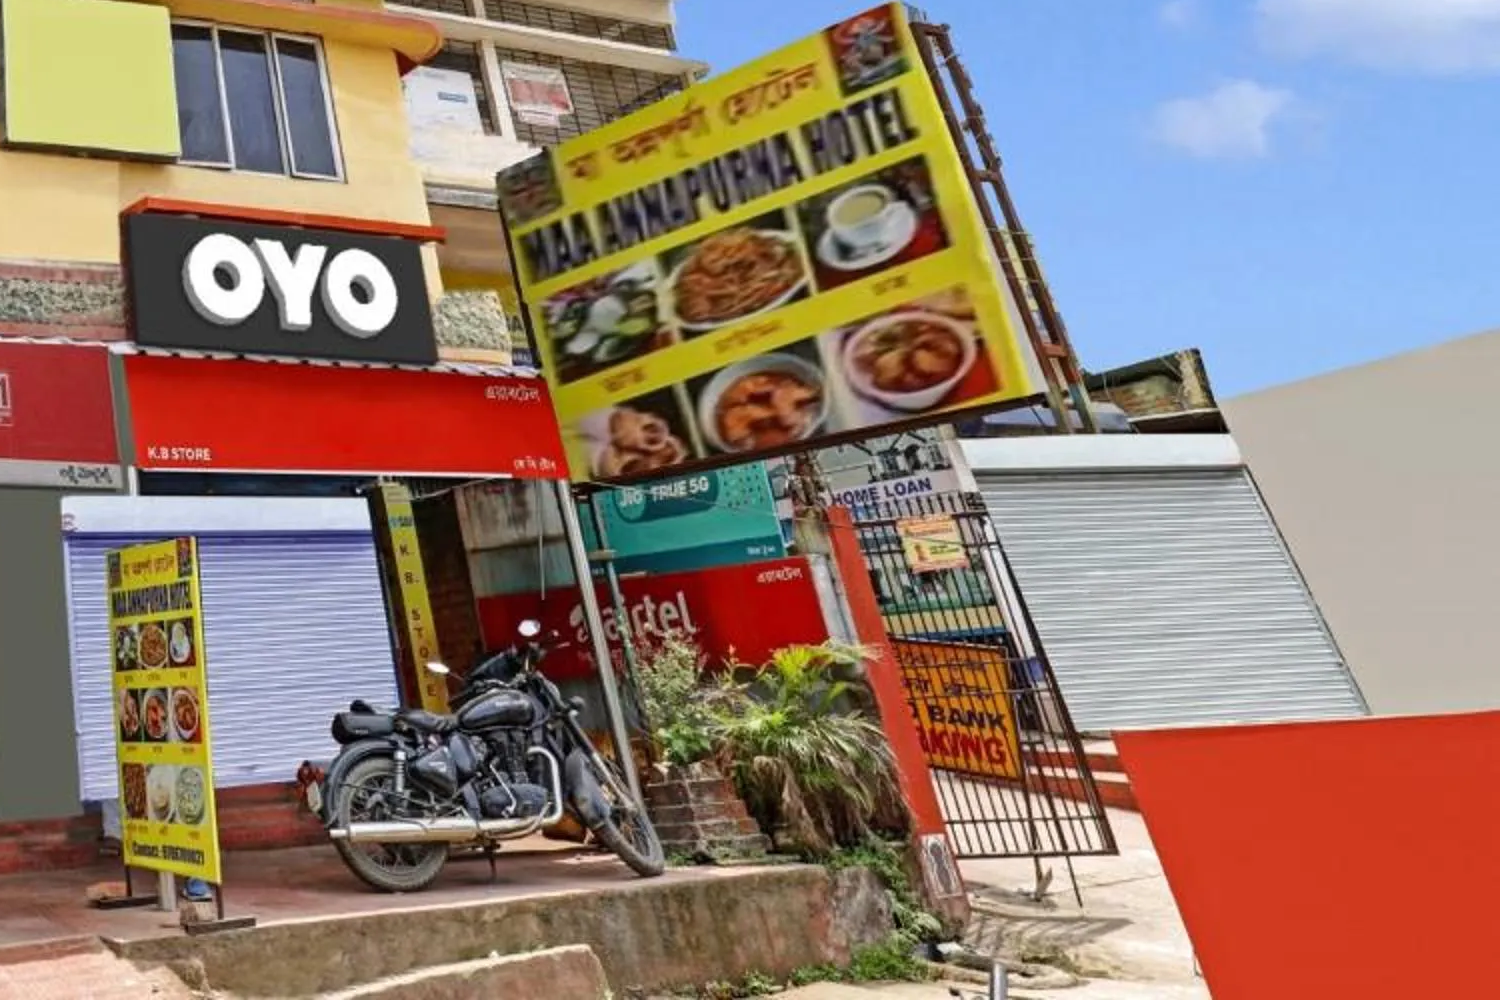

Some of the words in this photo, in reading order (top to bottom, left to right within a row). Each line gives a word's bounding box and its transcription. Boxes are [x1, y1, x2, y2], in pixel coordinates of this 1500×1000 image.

[518, 209, 599, 284] MAA
[596, 130, 805, 246] ANNAPURNA
[799, 87, 921, 175] HOTEL
[182, 233, 398, 338] OYO
[171, 447, 212, 461] STORE
[650, 480, 688, 502] TRUE
[689, 476, 710, 495] 5G
[831, 486, 881, 505] HOME
[884, 477, 933, 497] LOAN
[928, 705, 1007, 730] BANK
